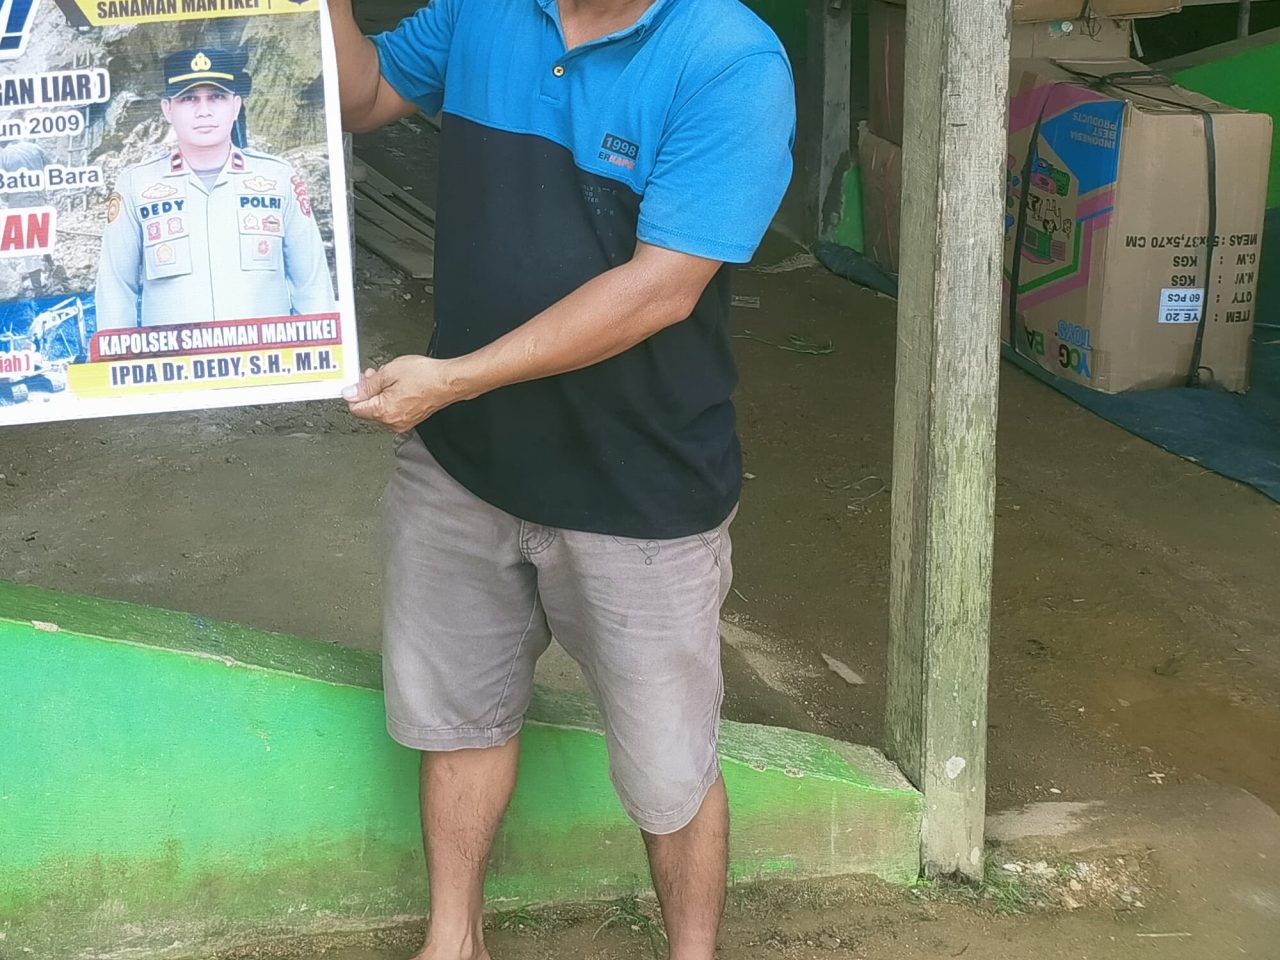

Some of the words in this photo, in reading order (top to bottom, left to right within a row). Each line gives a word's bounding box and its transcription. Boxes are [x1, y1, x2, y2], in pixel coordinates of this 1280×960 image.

[41, 74, 92, 103] LIAR
[28, 115, 81, 137] 2009
[1072, 112, 1117, 130] PRODUCTS
[1093, 127, 1116, 139] BEST
[605, 137, 637, 157] 1998
[48, 166, 100, 187] Bara
[140, 199, 185, 219] DEDY
[239, 197, 282, 210] POLRI
[1125, 235, 1146, 247] CM
[1229, 233, 1258, 247] MEAS
[1172, 255, 1198, 267] KGS
[1236, 253, 1255, 265] G.W
[1170, 275, 1196, 286] KGS
[1167, 293, 1187, 303] PCS
[1189, 293, 1201, 303] 60
[1231, 291, 1252, 304] QTY
[1165, 312, 1180, 322] 20
[1182, 312, 1199, 322] YE
[1225, 310, 1250, 323] ITEM
[98, 330, 178, 356] KAPOLSEK
[180, 326, 259, 352] SANAMAN
[262, 319, 338, 344] MANTIKEI
[110, 364, 158, 388] IPDA
[161, 362, 189, 384] Dr.
[193, 358, 246, 385] DEDY,
[249, 354, 291, 378] S.H.,
[294, 350, 338, 373] M.H.
